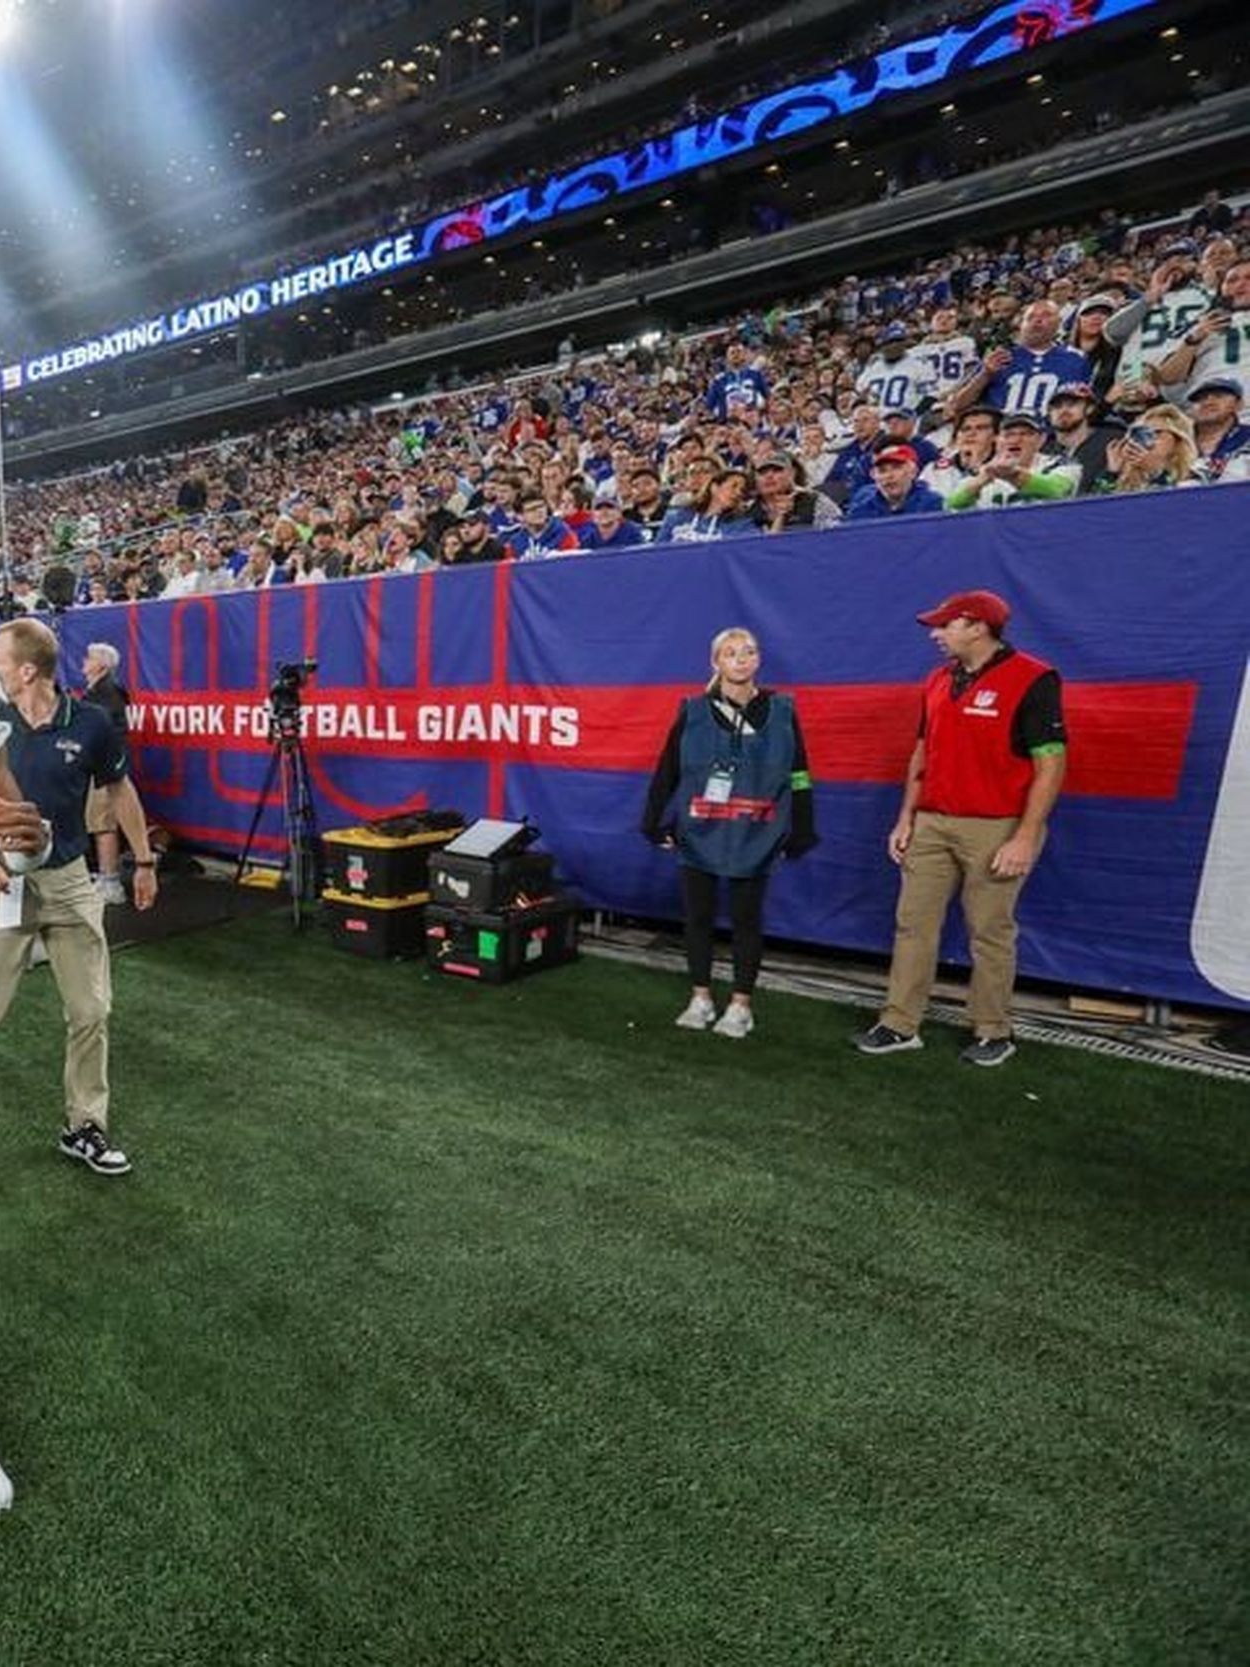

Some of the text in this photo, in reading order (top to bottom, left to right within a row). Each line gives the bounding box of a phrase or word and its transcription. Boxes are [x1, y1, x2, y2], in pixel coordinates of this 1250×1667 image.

[26, 232, 416, 382] CELEBRATING LATINO HERITAGE
[1003, 372, 1059, 418] 10
[152, 705, 226, 735] YORK
[233, 705, 406, 742] FOTBALL
[416, 703, 580, 748] GIANTS
